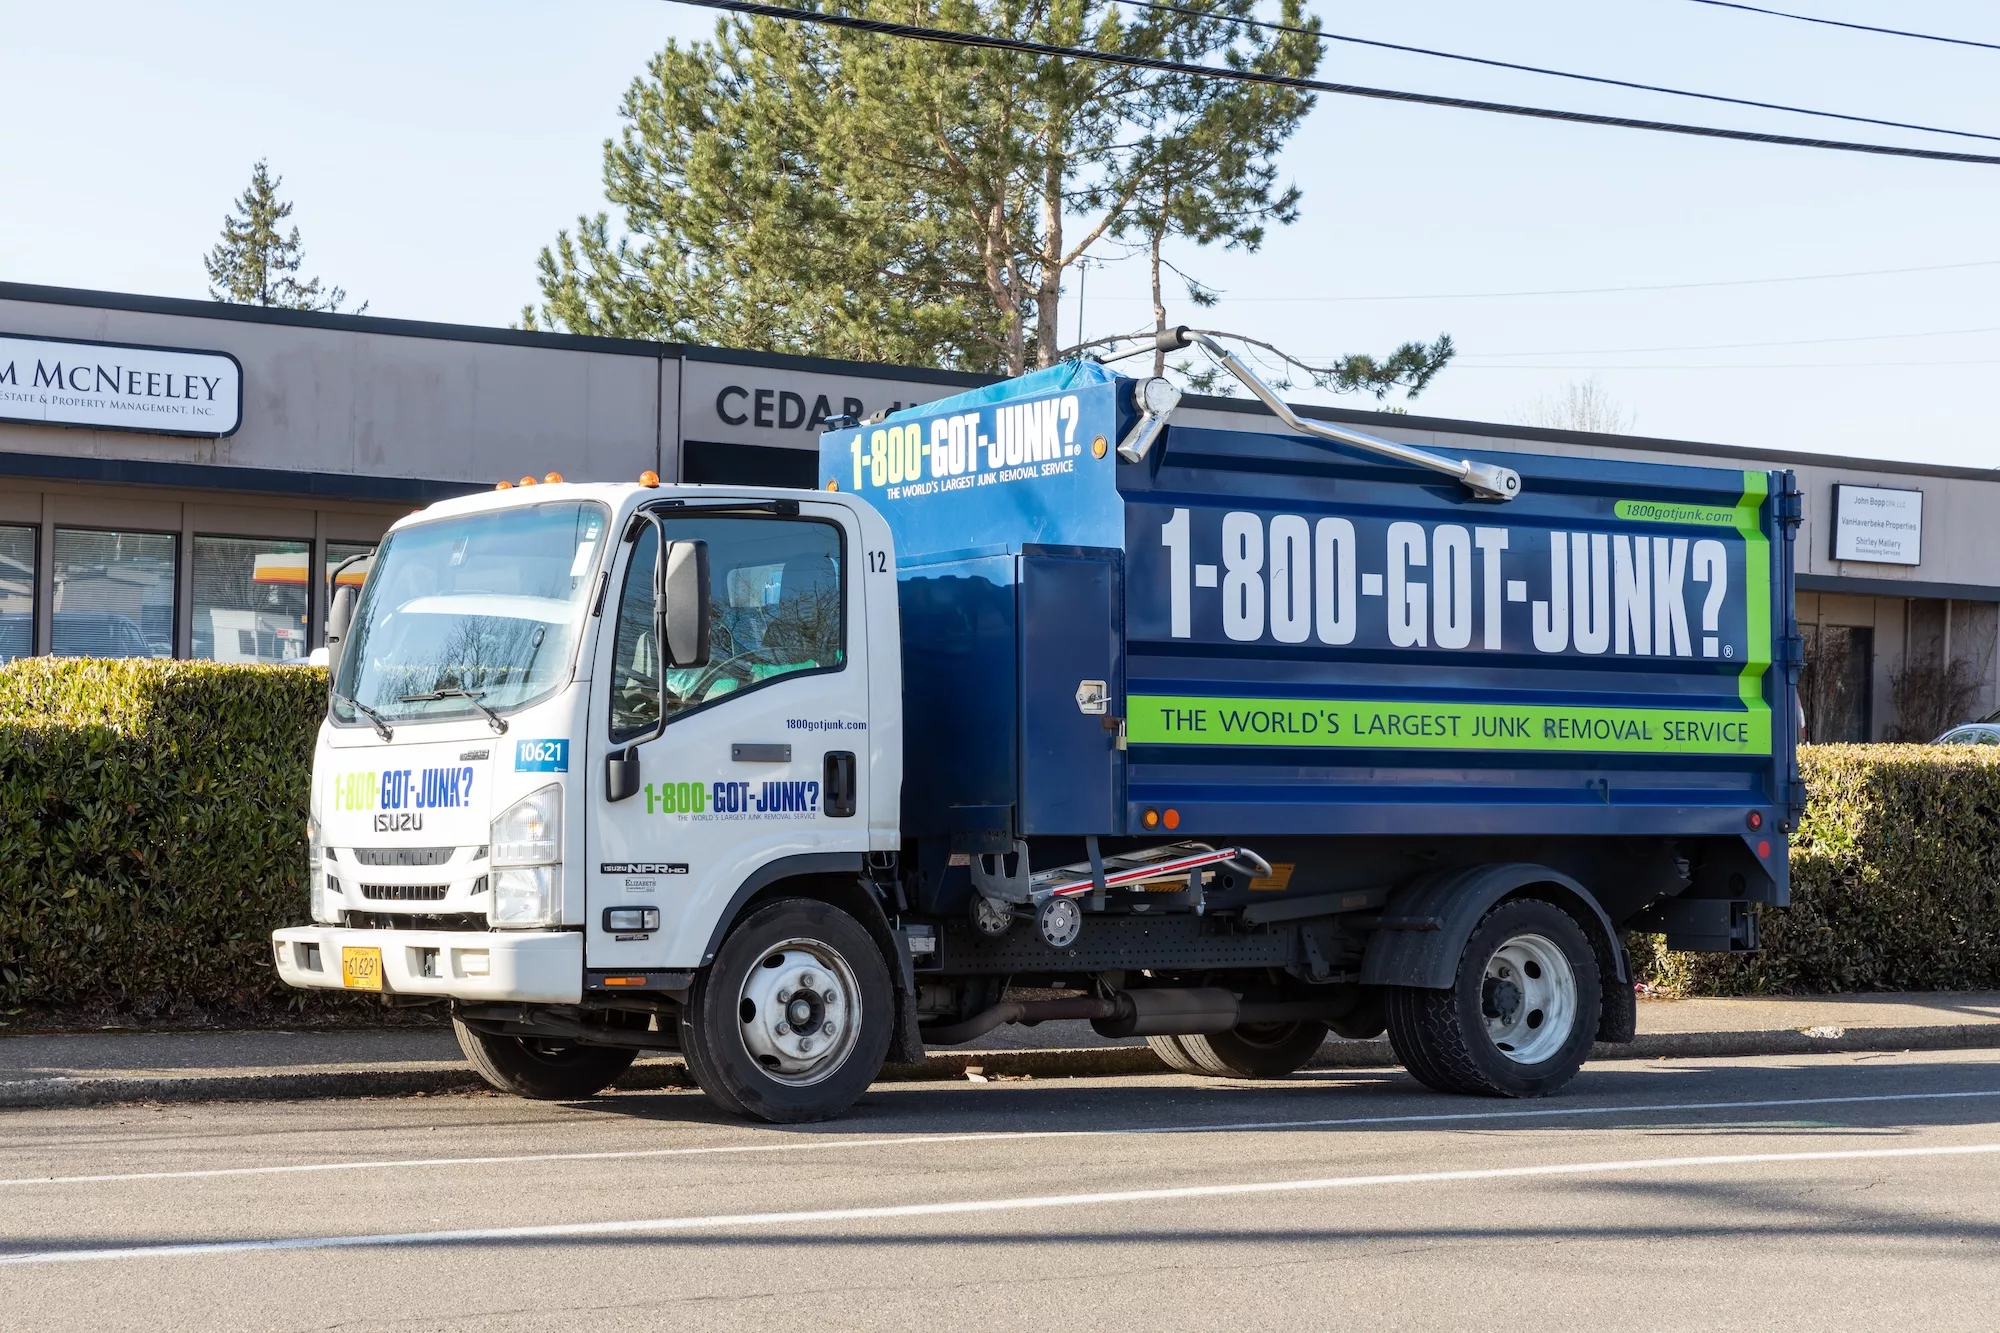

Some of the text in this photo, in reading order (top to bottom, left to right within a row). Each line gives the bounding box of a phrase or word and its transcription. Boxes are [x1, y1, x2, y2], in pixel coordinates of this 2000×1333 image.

[40, 394, 48, 404] &
[52, 396, 106, 408] PROPERTY
[716, 385, 864, 430] CEDAR
[886, 460, 1073, 500] THE WORLD'S LARGEST JUNK REMOVAL SERVICE
[1854, 496, 1869, 504] John
[1870, 497, 1885, 508] Bopp
[1624, 504, 1733, 524] 1800gotjunk.com
[1886, 520, 1917, 531] Properties
[1856, 536, 1878, 547] Shirley
[868, 551, 887, 573] 12
[786, 719, 867, 731] 1800gotjunk.com
[1160, 709, 1749, 743] THE WORLD'S LARGEST JUNK REMOVAL SERVICE
[520, 742, 561, 761] 10621
[335, 767, 473, 811] 1-800-GOT-JUNK?
[374, 812, 423, 832] ISUZU
[627, 864, 669, 873] NPR
